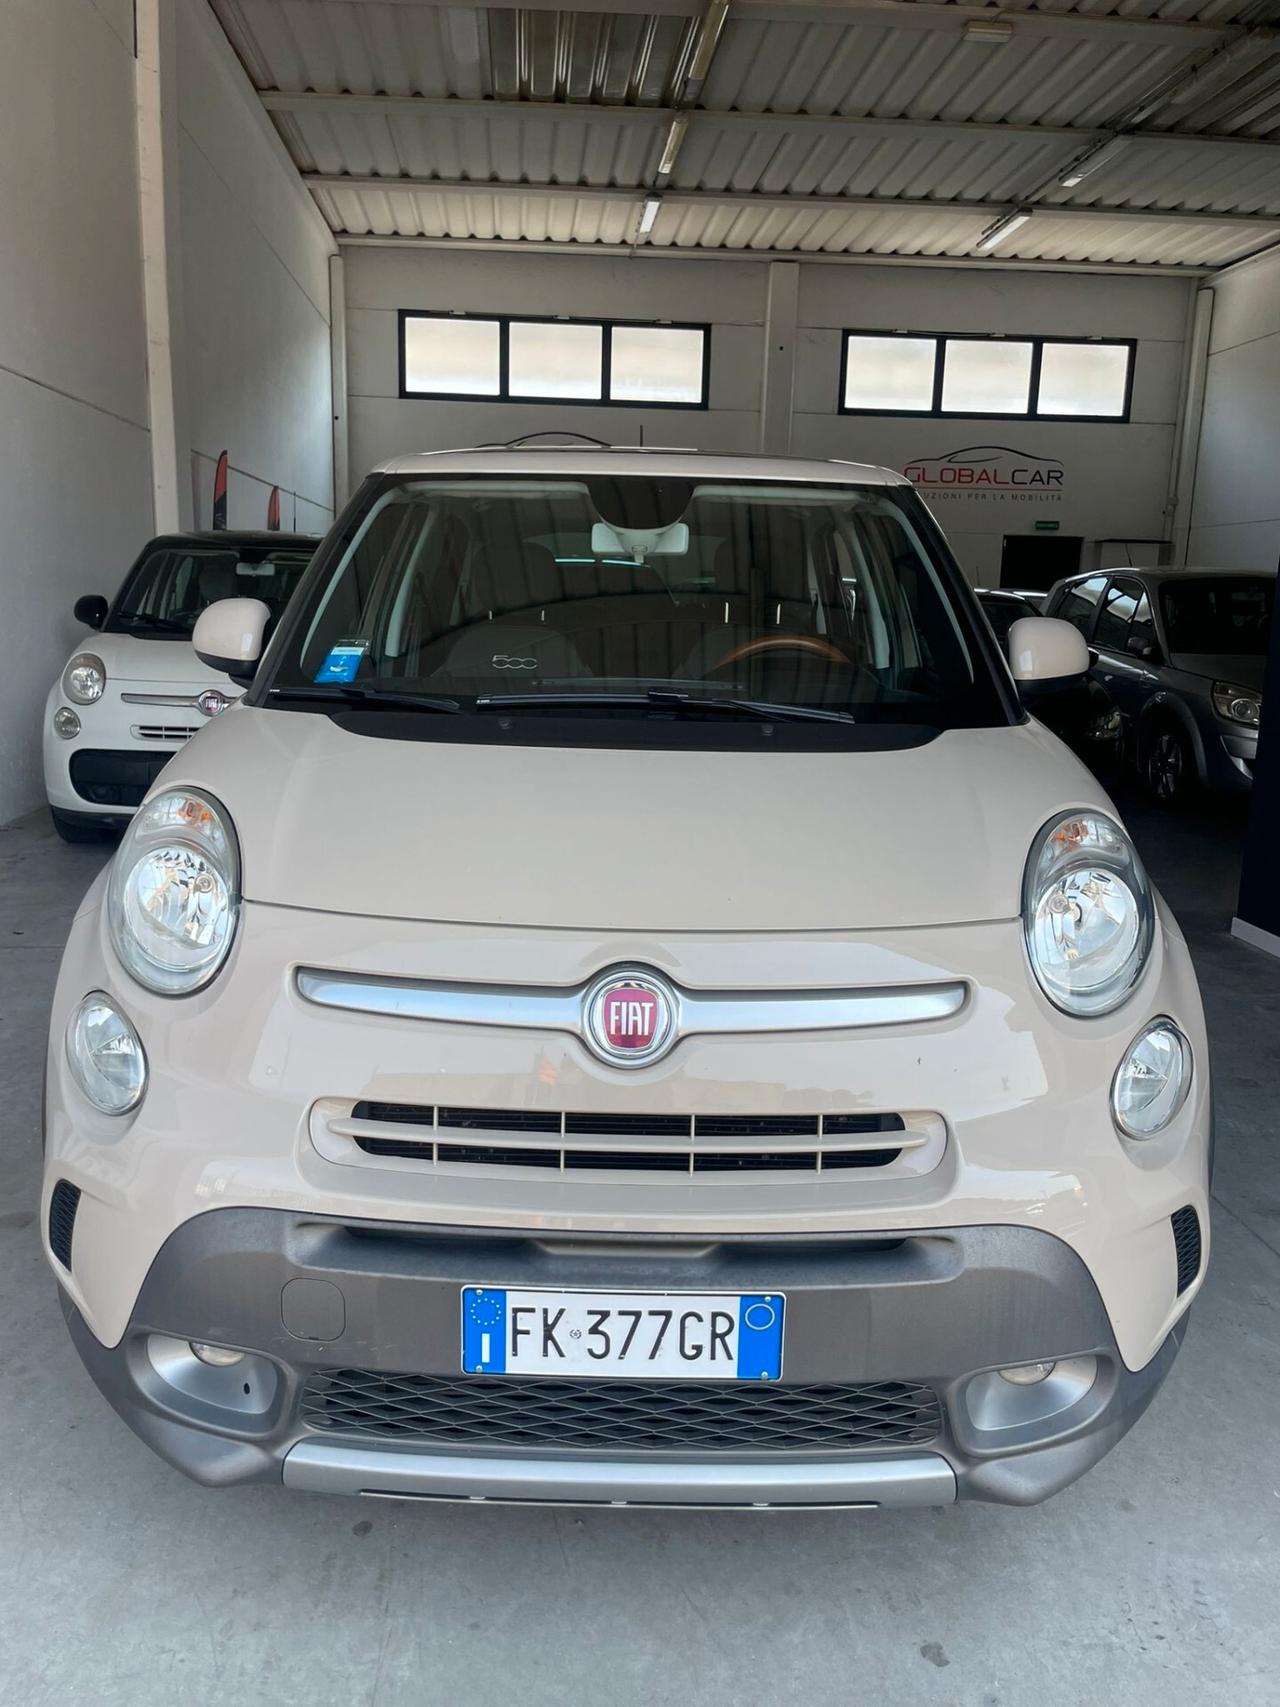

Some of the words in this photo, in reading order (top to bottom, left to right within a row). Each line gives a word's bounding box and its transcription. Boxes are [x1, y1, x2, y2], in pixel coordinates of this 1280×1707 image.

[904, 466, 1063, 486] GLOBALCAR
[967, 492, 987, 501] PER
[993, 493, 1005, 502] LA
[492, 654, 538, 670] 500
[610, 1001, 654, 1036] FIAT
